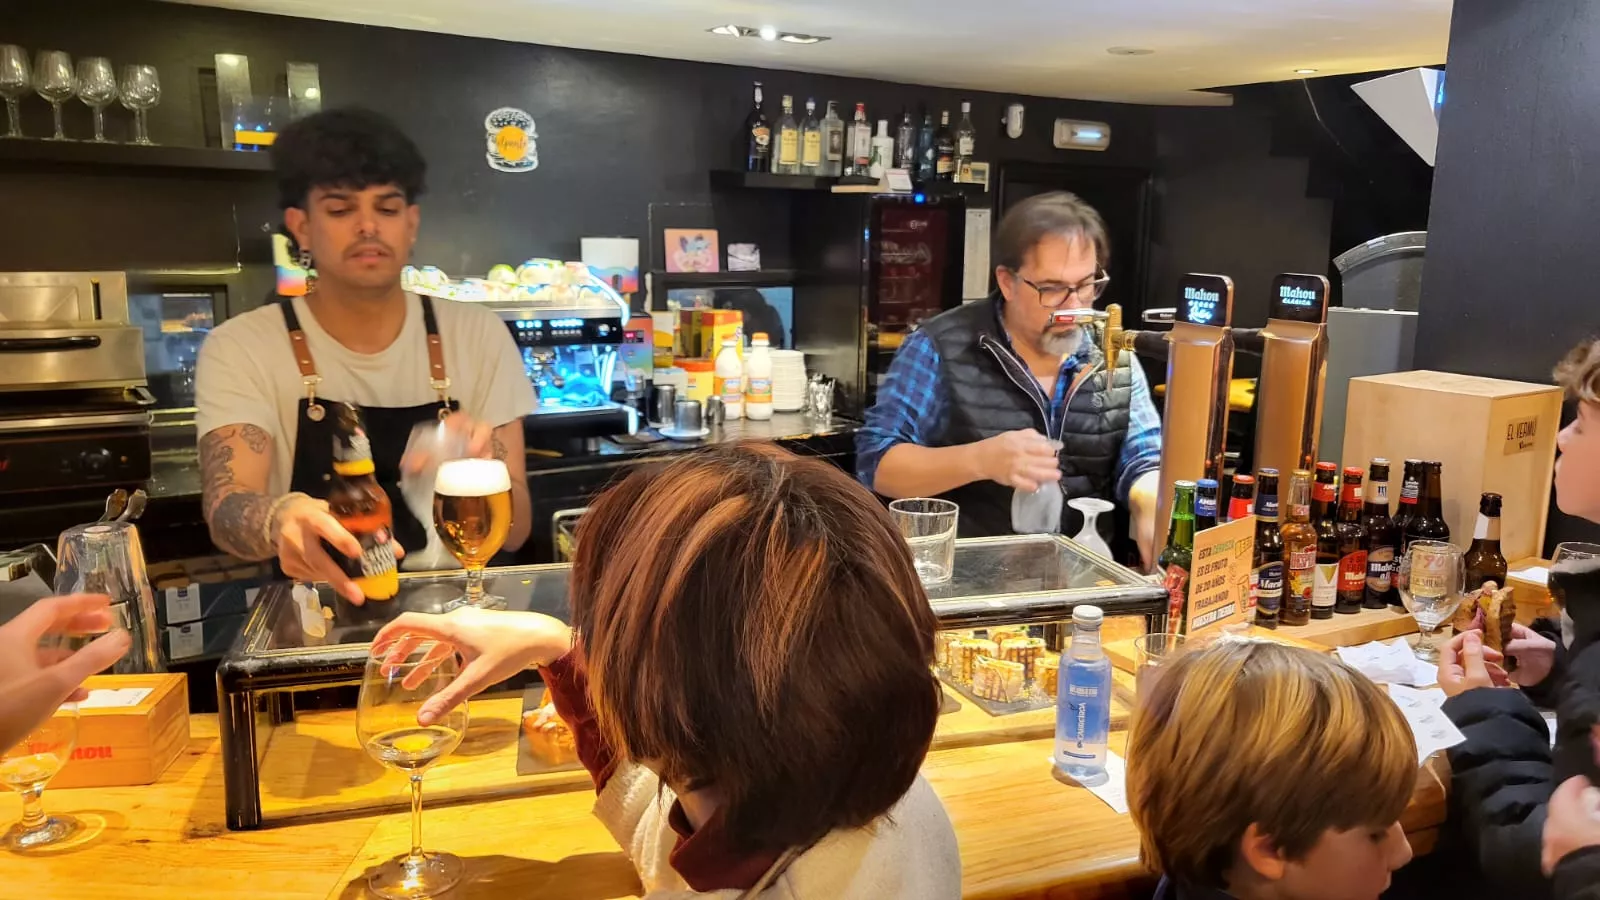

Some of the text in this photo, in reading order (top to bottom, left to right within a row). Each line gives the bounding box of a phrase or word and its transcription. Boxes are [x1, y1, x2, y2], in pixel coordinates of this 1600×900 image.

[1184, 286, 1220, 302] Mahou
[1279, 285, 1316, 300] Mahou
[1507, 423, 1514, 441] EL
[1198, 547, 1211, 560] ESTA
[1196, 558, 1228, 578] ES EL FRUTO
[1195, 582, 1203, 595] DE
[1203, 580, 1211, 592] 20
[1194, 590, 1229, 612] TRABAJANDO
